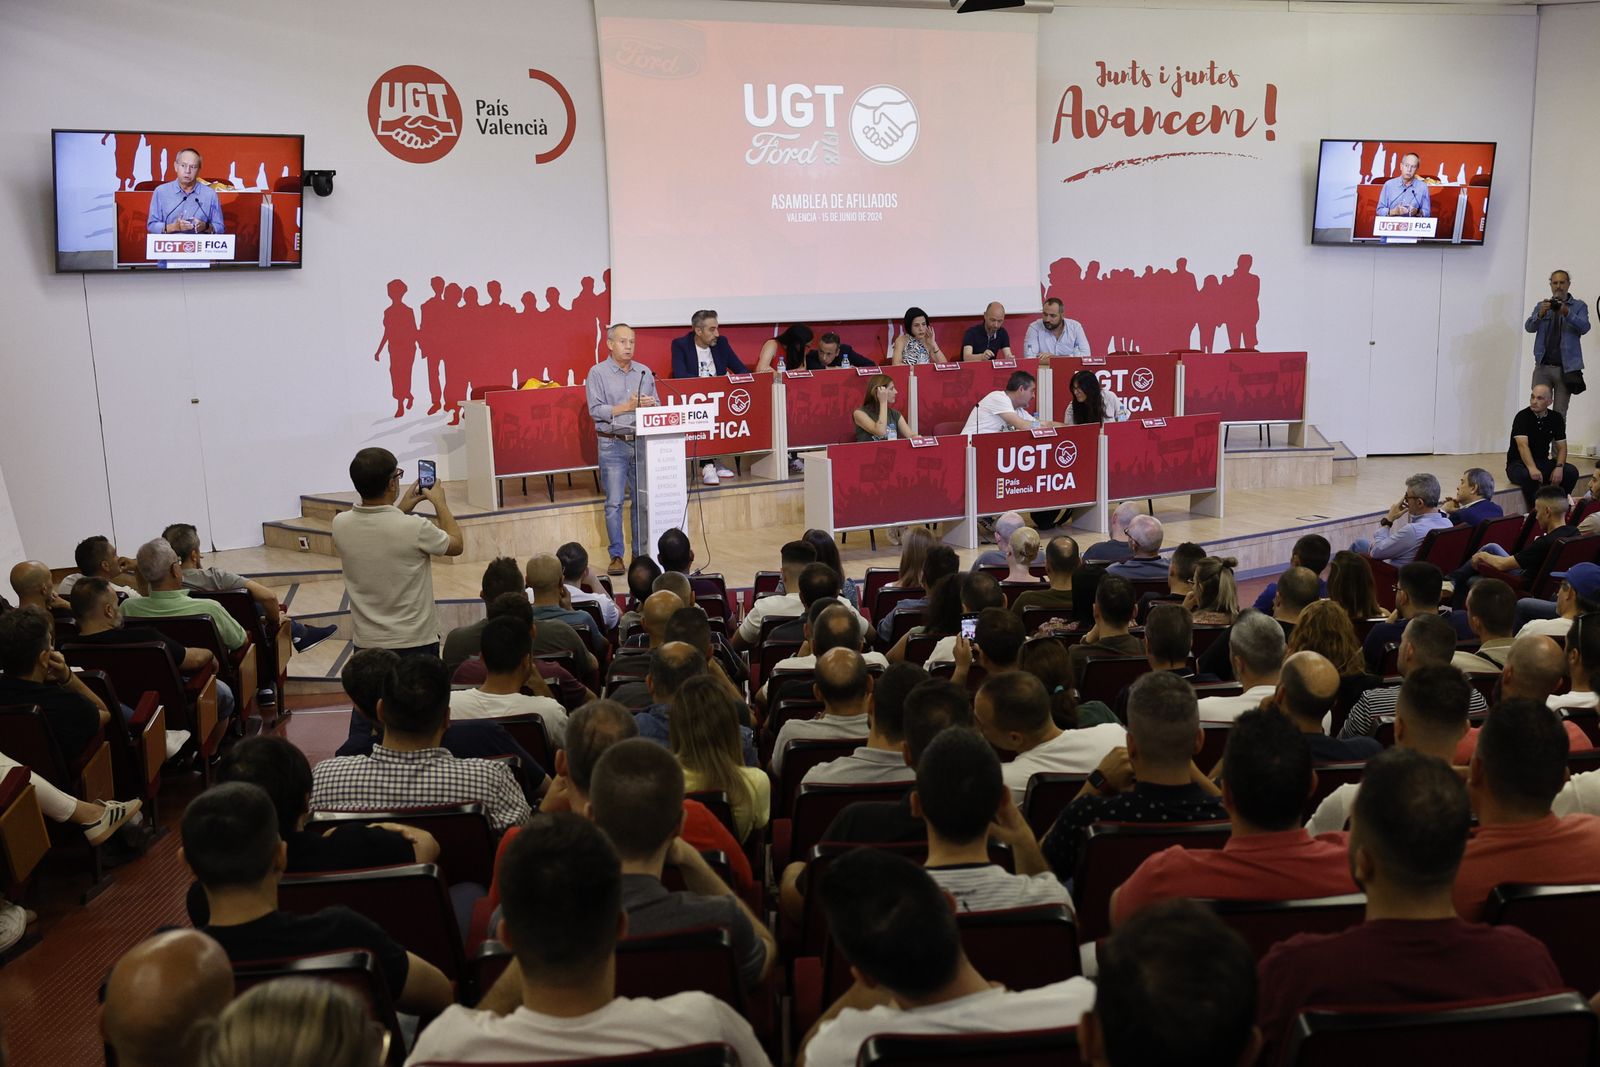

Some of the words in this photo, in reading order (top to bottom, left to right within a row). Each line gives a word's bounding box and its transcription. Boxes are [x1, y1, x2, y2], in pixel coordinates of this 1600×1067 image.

[1096, 60, 1152, 87] Junts
[1159, 66, 1170, 84] i
[1171, 60, 1240, 98] juntes
[379, 82, 449, 121] UGT
[476, 99, 509, 116] País
[743, 83, 844, 128] UGT
[476, 119, 548, 136] Valencià
[745, 132, 819, 166] Ford
[771, 193, 828, 209] ASAMBLEA
[831, 193, 844, 208] DE
[847, 192, 898, 208] AFILIADOS
[787, 212, 817, 223] VALENCIA
[822, 212, 829, 222] 15
[830, 212, 838, 222] DE
[839, 212, 857, 222] JUNIO
[858, 212, 866, 222] DE
[867, 211, 883, 222] 2024
[1380, 221, 1399, 231] UGT
[155, 241, 182, 252] UGT
[205, 241, 228, 249] FICA
[1075, 370, 1128, 391] GT
[1118, 396, 1152, 412] ICA
[644, 414, 667, 427] UGT
[688, 410, 708, 420] FICA
[685, 431, 706, 441] lencià
[997, 443, 1052, 473] UGT
[1005, 478, 1020, 486] País
[1005, 485, 1034, 495] Valencià
[1036, 472, 1076, 493] FICA
